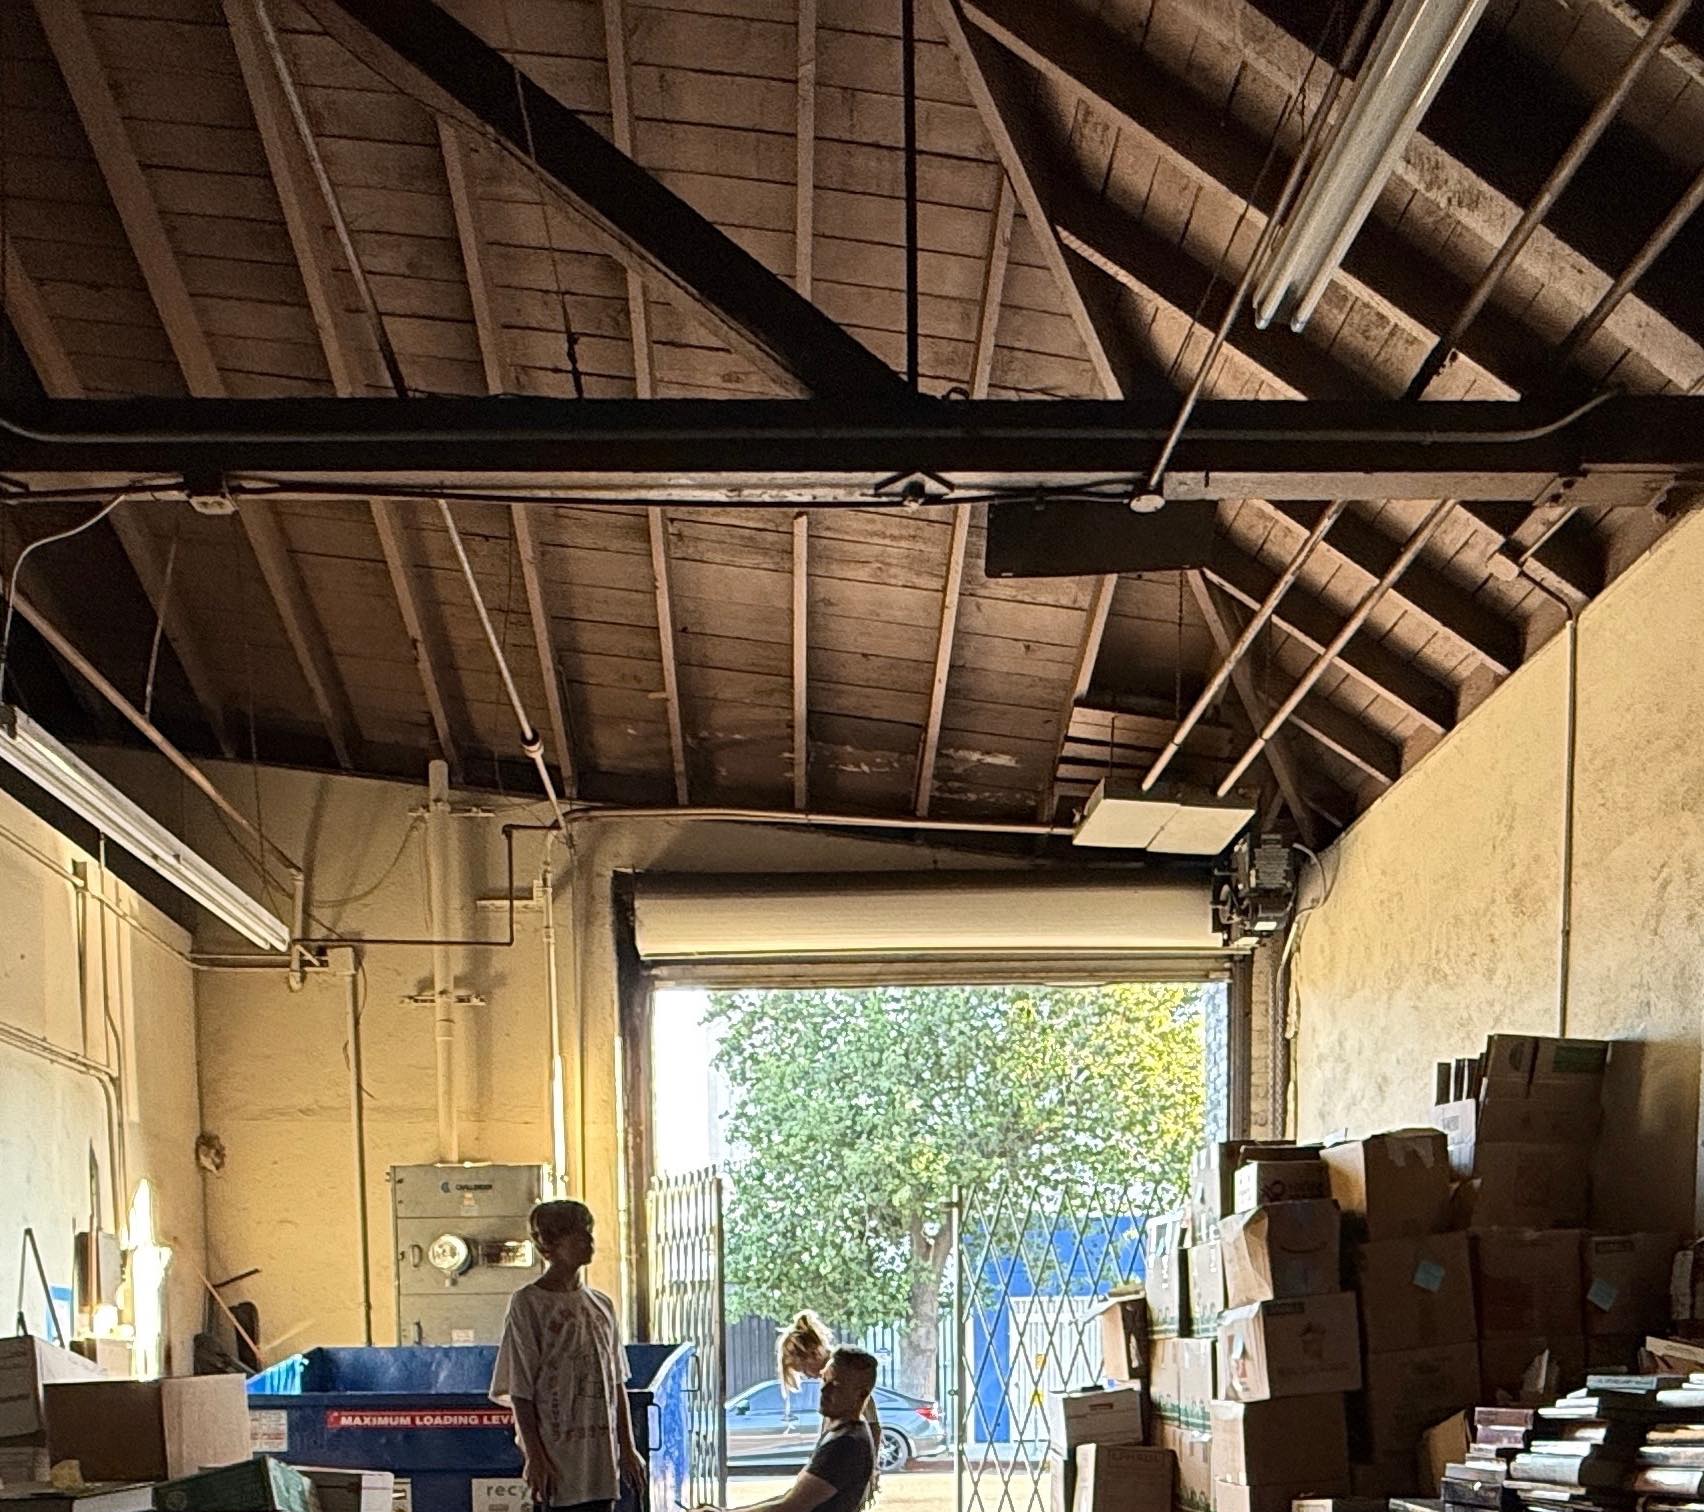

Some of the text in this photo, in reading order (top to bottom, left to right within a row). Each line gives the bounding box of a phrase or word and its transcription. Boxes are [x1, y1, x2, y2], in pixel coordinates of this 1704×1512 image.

[340, 1415, 411, 1425] MAXIMUM
[415, 1415, 478, 1425] LOADING
[486, 1484, 529, 1500] recy
